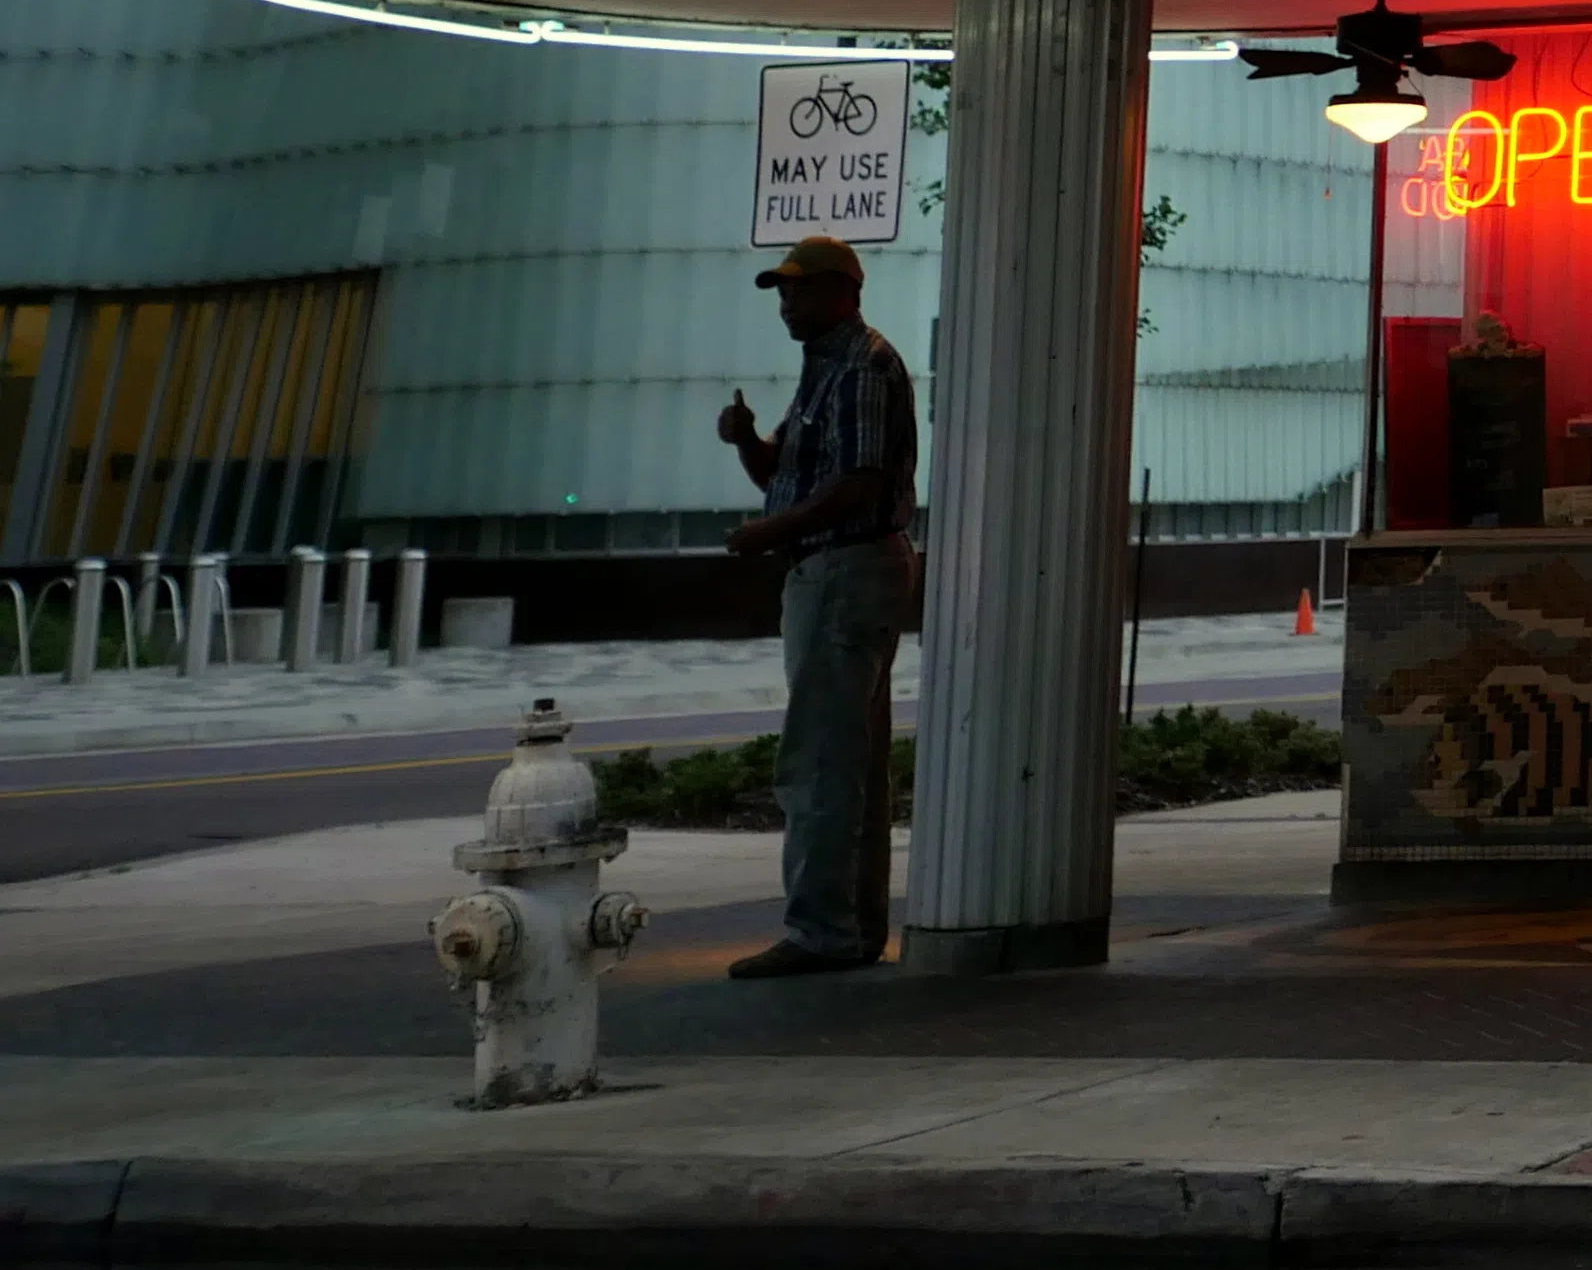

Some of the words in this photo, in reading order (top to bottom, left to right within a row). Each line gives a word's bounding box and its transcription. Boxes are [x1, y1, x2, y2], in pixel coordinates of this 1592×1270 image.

[770, 154, 827, 185] MAY
[839, 152, 889, 181] USE
[766, 194, 820, 223] FULL
[831, 191, 887, 220] LANE
